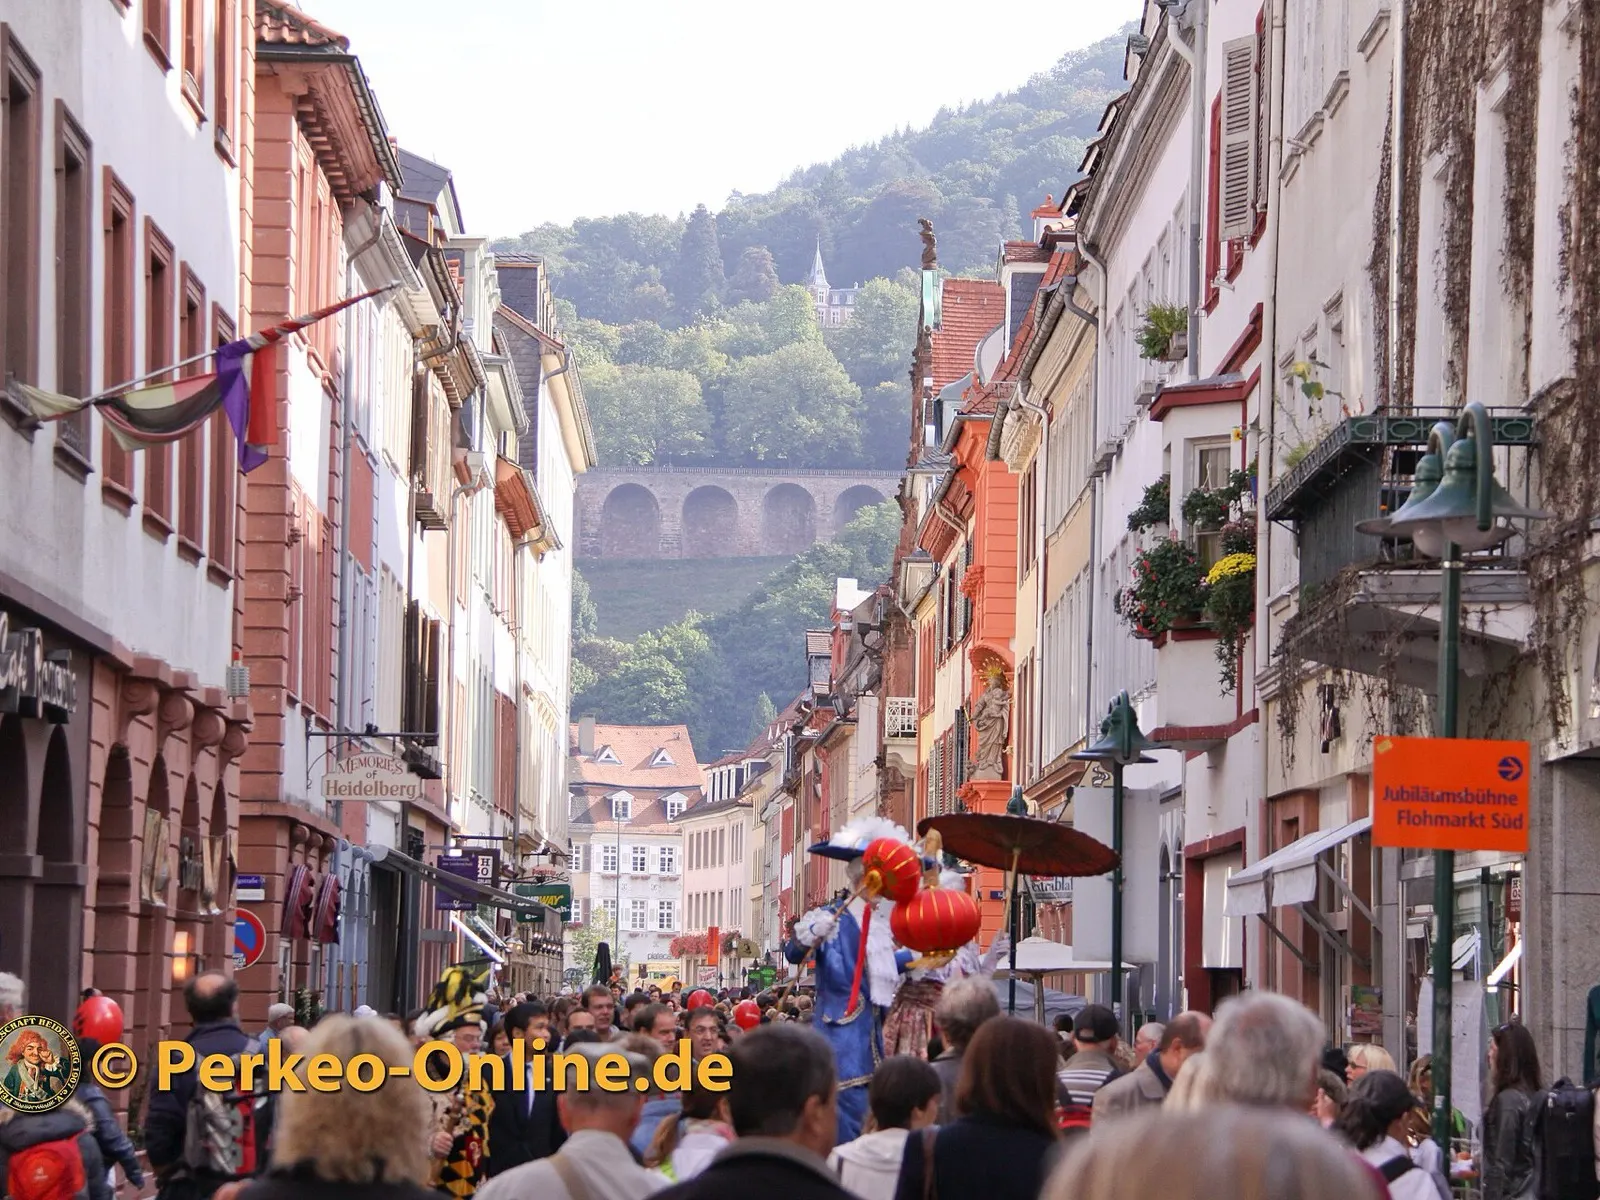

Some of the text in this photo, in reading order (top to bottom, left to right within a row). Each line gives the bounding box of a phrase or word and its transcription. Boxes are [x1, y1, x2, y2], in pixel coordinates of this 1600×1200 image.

[338, 756, 404, 775] MEMORIES
[366, 770, 377, 779] of
[326, 780, 416, 799] Heidelberg
[1383, 786, 1518, 806] Jubiläumsbühne
[1397, 809, 1523, 830] Flohmarkt Süd
